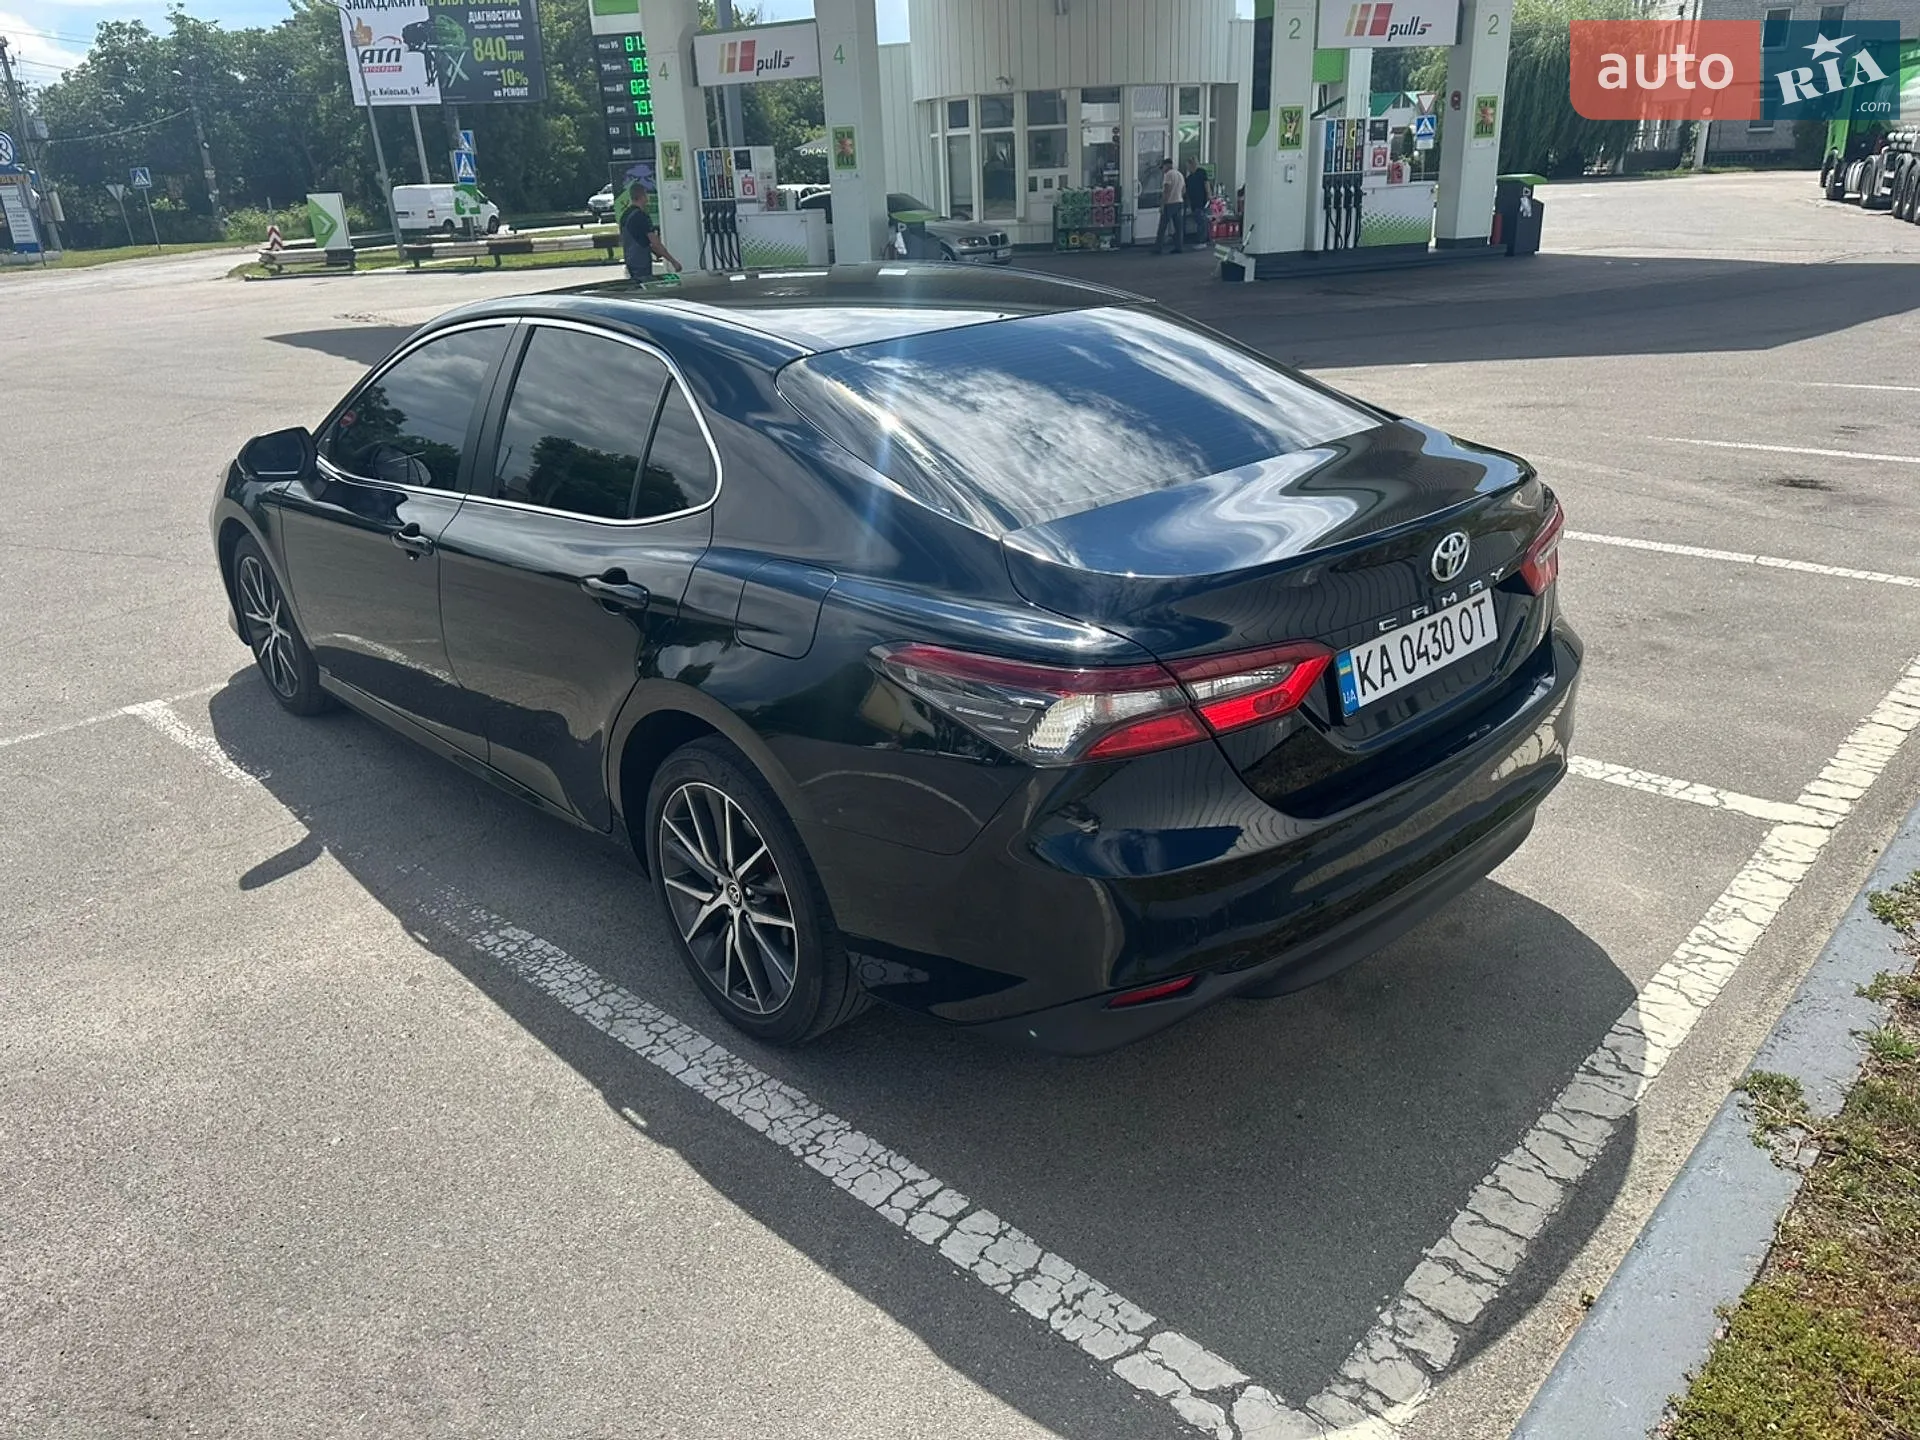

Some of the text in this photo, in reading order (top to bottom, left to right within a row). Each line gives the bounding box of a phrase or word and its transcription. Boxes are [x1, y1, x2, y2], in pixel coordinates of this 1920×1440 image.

[468, 9, 522, 23] ДІАГНОСТИКА
[1487, 13, 1500, 35] 2
[1288, 17, 1302, 40] 2
[1387, 16, 1433, 42] pulls
[473, 36, 507, 62] 840
[833, 44, 846, 65] 4
[658, 62, 670, 81] 4
[756, 50, 795, 77] pulls
[502, 87, 529, 97] РЕМОНТ
[1378, 567, 1505, 631] CAMRY
[1356, 597, 1487, 697] KA 0430 OT
[1342, 690, 1358, 705] UA
